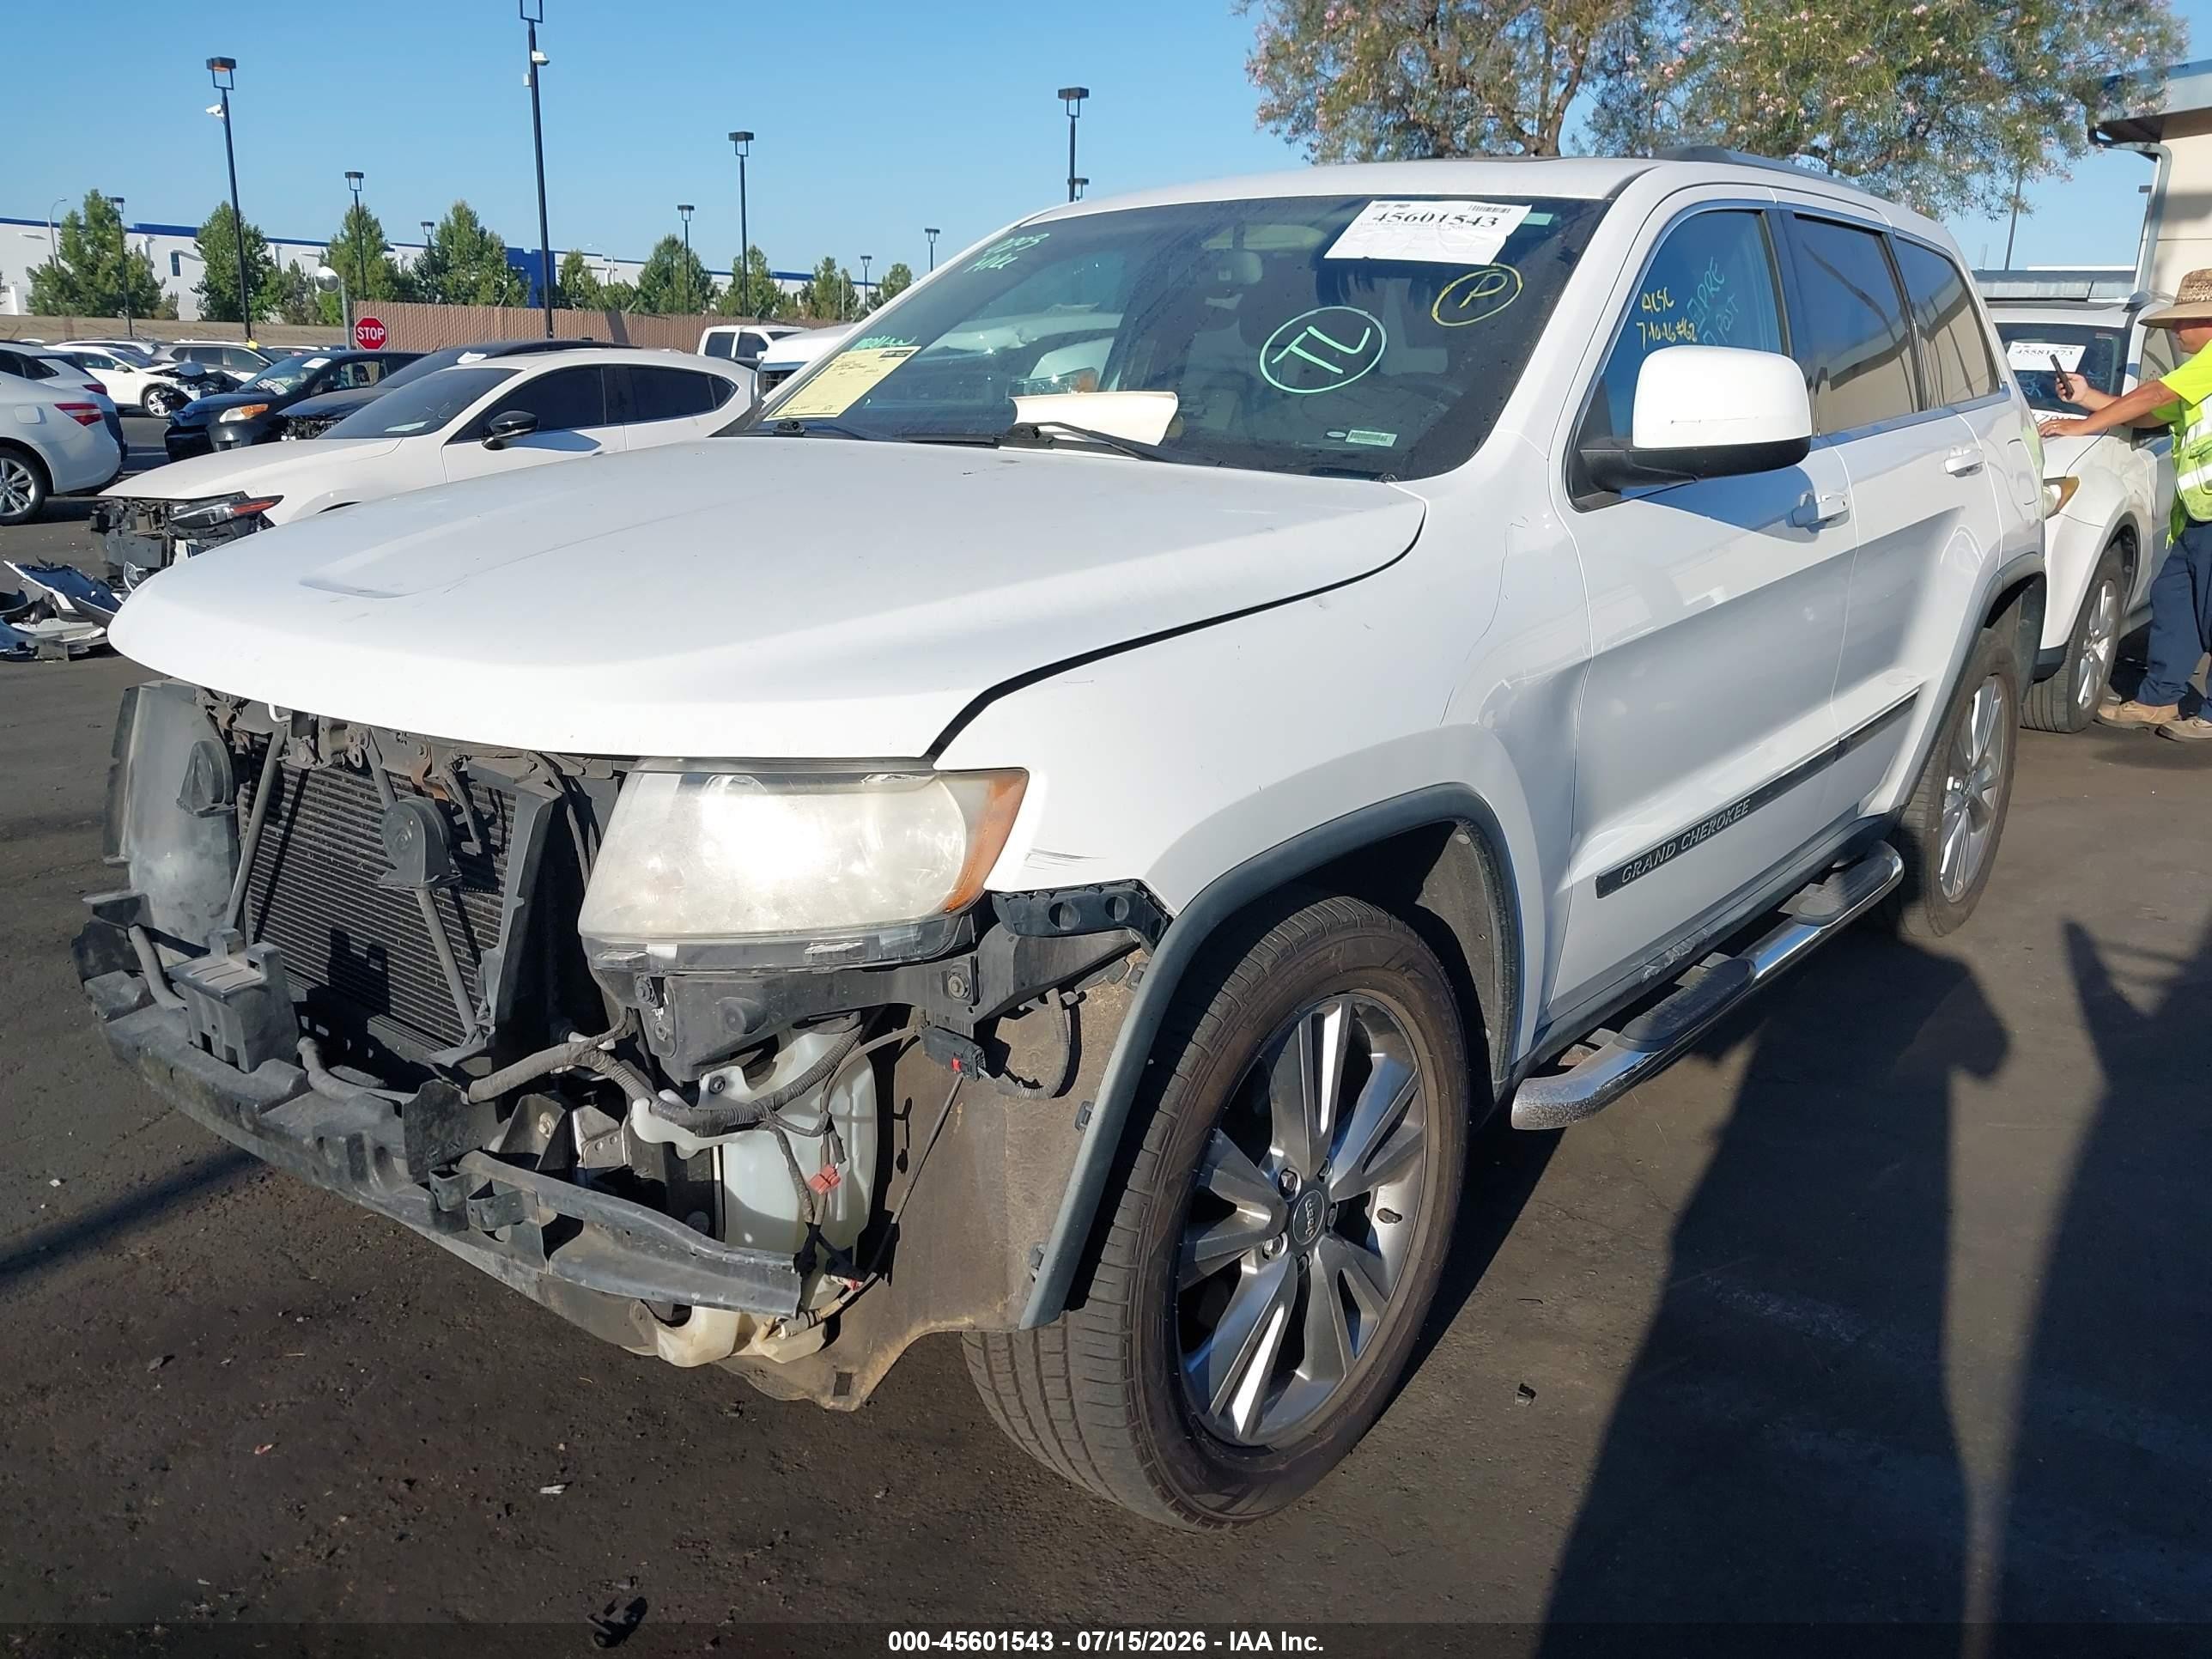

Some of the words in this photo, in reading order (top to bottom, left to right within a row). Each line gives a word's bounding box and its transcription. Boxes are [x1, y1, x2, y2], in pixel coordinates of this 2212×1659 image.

[1373, 211, 1499, 228] 45601543
[357, 326, 385, 341] STOP
[1621, 842, 1676, 884] GRAND
[1680, 799, 1751, 850] CHEROKEE
